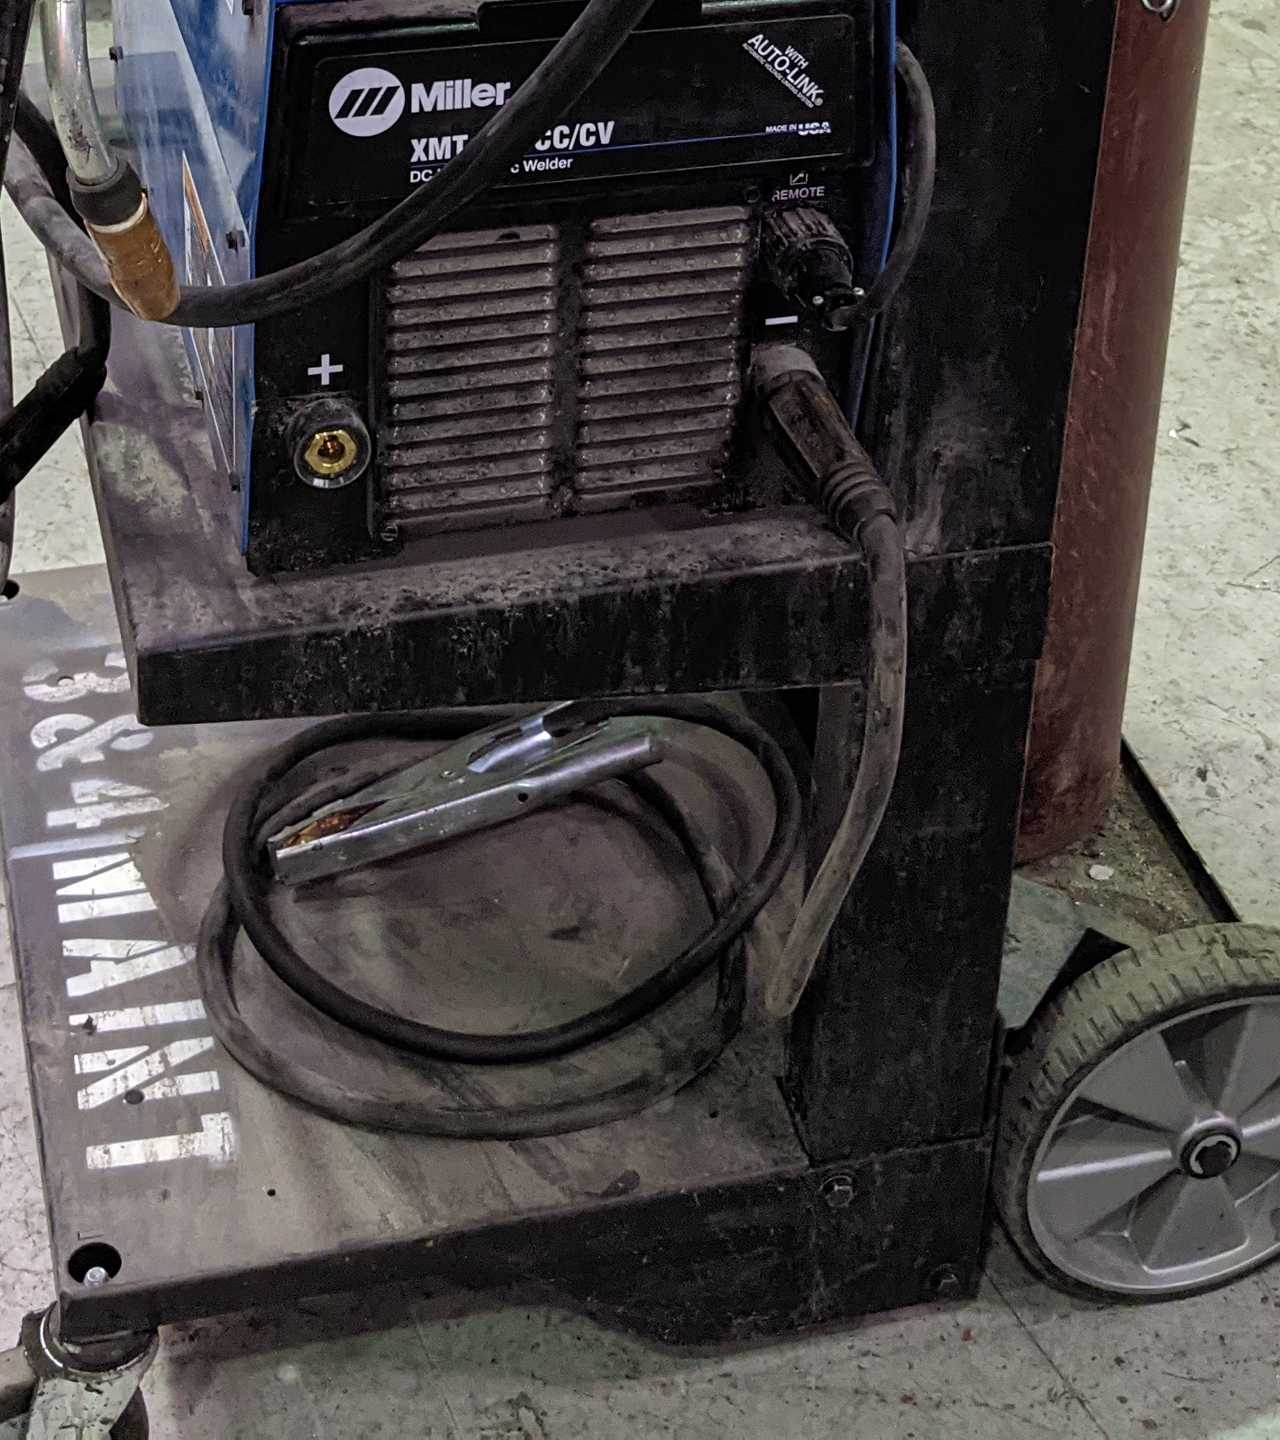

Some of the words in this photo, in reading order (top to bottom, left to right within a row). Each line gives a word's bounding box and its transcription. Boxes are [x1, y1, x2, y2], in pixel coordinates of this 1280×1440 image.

[784, 45, 809, 70] WITH
[410, 79, 512, 114] Miller
[765, 124, 788, 134] MADE
[410, 133, 469, 163] XMT
[523, 157, 574, 172] Welder
[771, 185, 825, 202] REMOTE
[52, 850, 238, 1172] MAINT
